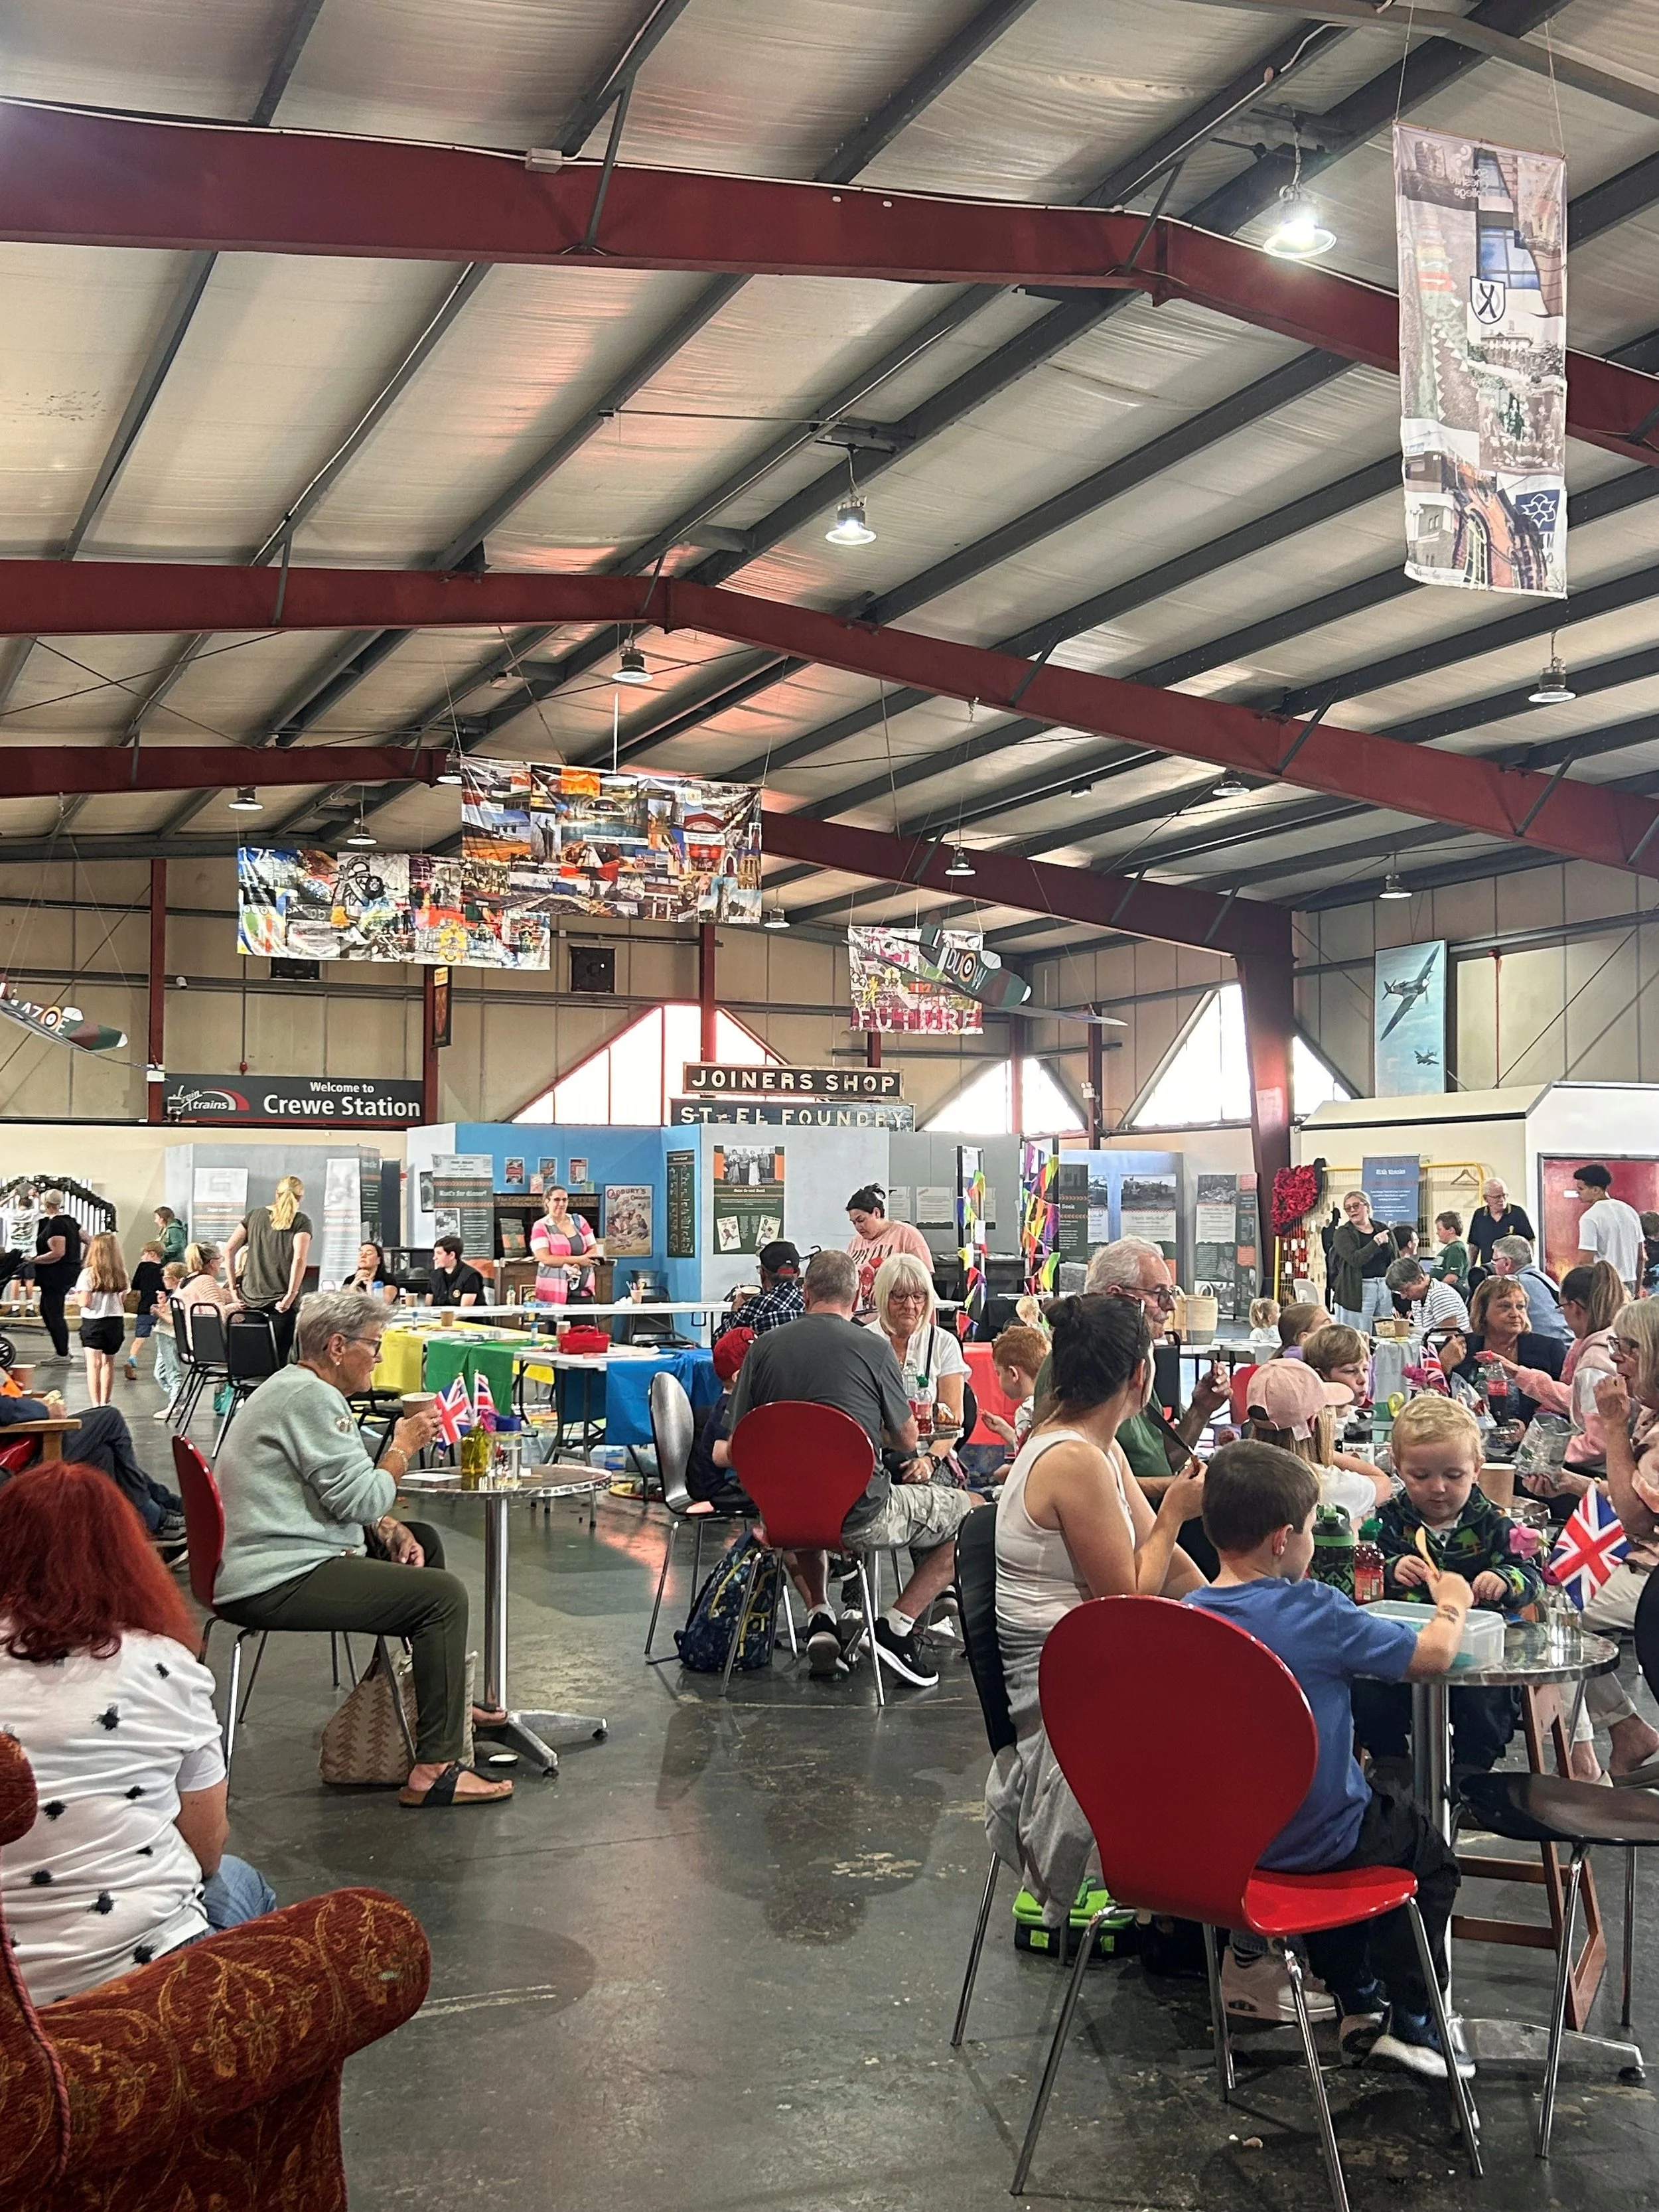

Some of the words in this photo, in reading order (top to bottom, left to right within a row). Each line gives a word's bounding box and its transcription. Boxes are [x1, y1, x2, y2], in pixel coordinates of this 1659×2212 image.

[310, 1082, 360, 1093] Welcome
[363, 1084, 374, 1093] to
[691, 1070, 814, 1090] JOINERS
[826, 1074, 895, 1093] SHOP
[193, 1100, 228, 1110] trains
[263, 1094, 334, 1115] Crewe
[342, 1096, 421, 1117] Station
[781, 1109, 904, 1128] FOUNDRY
